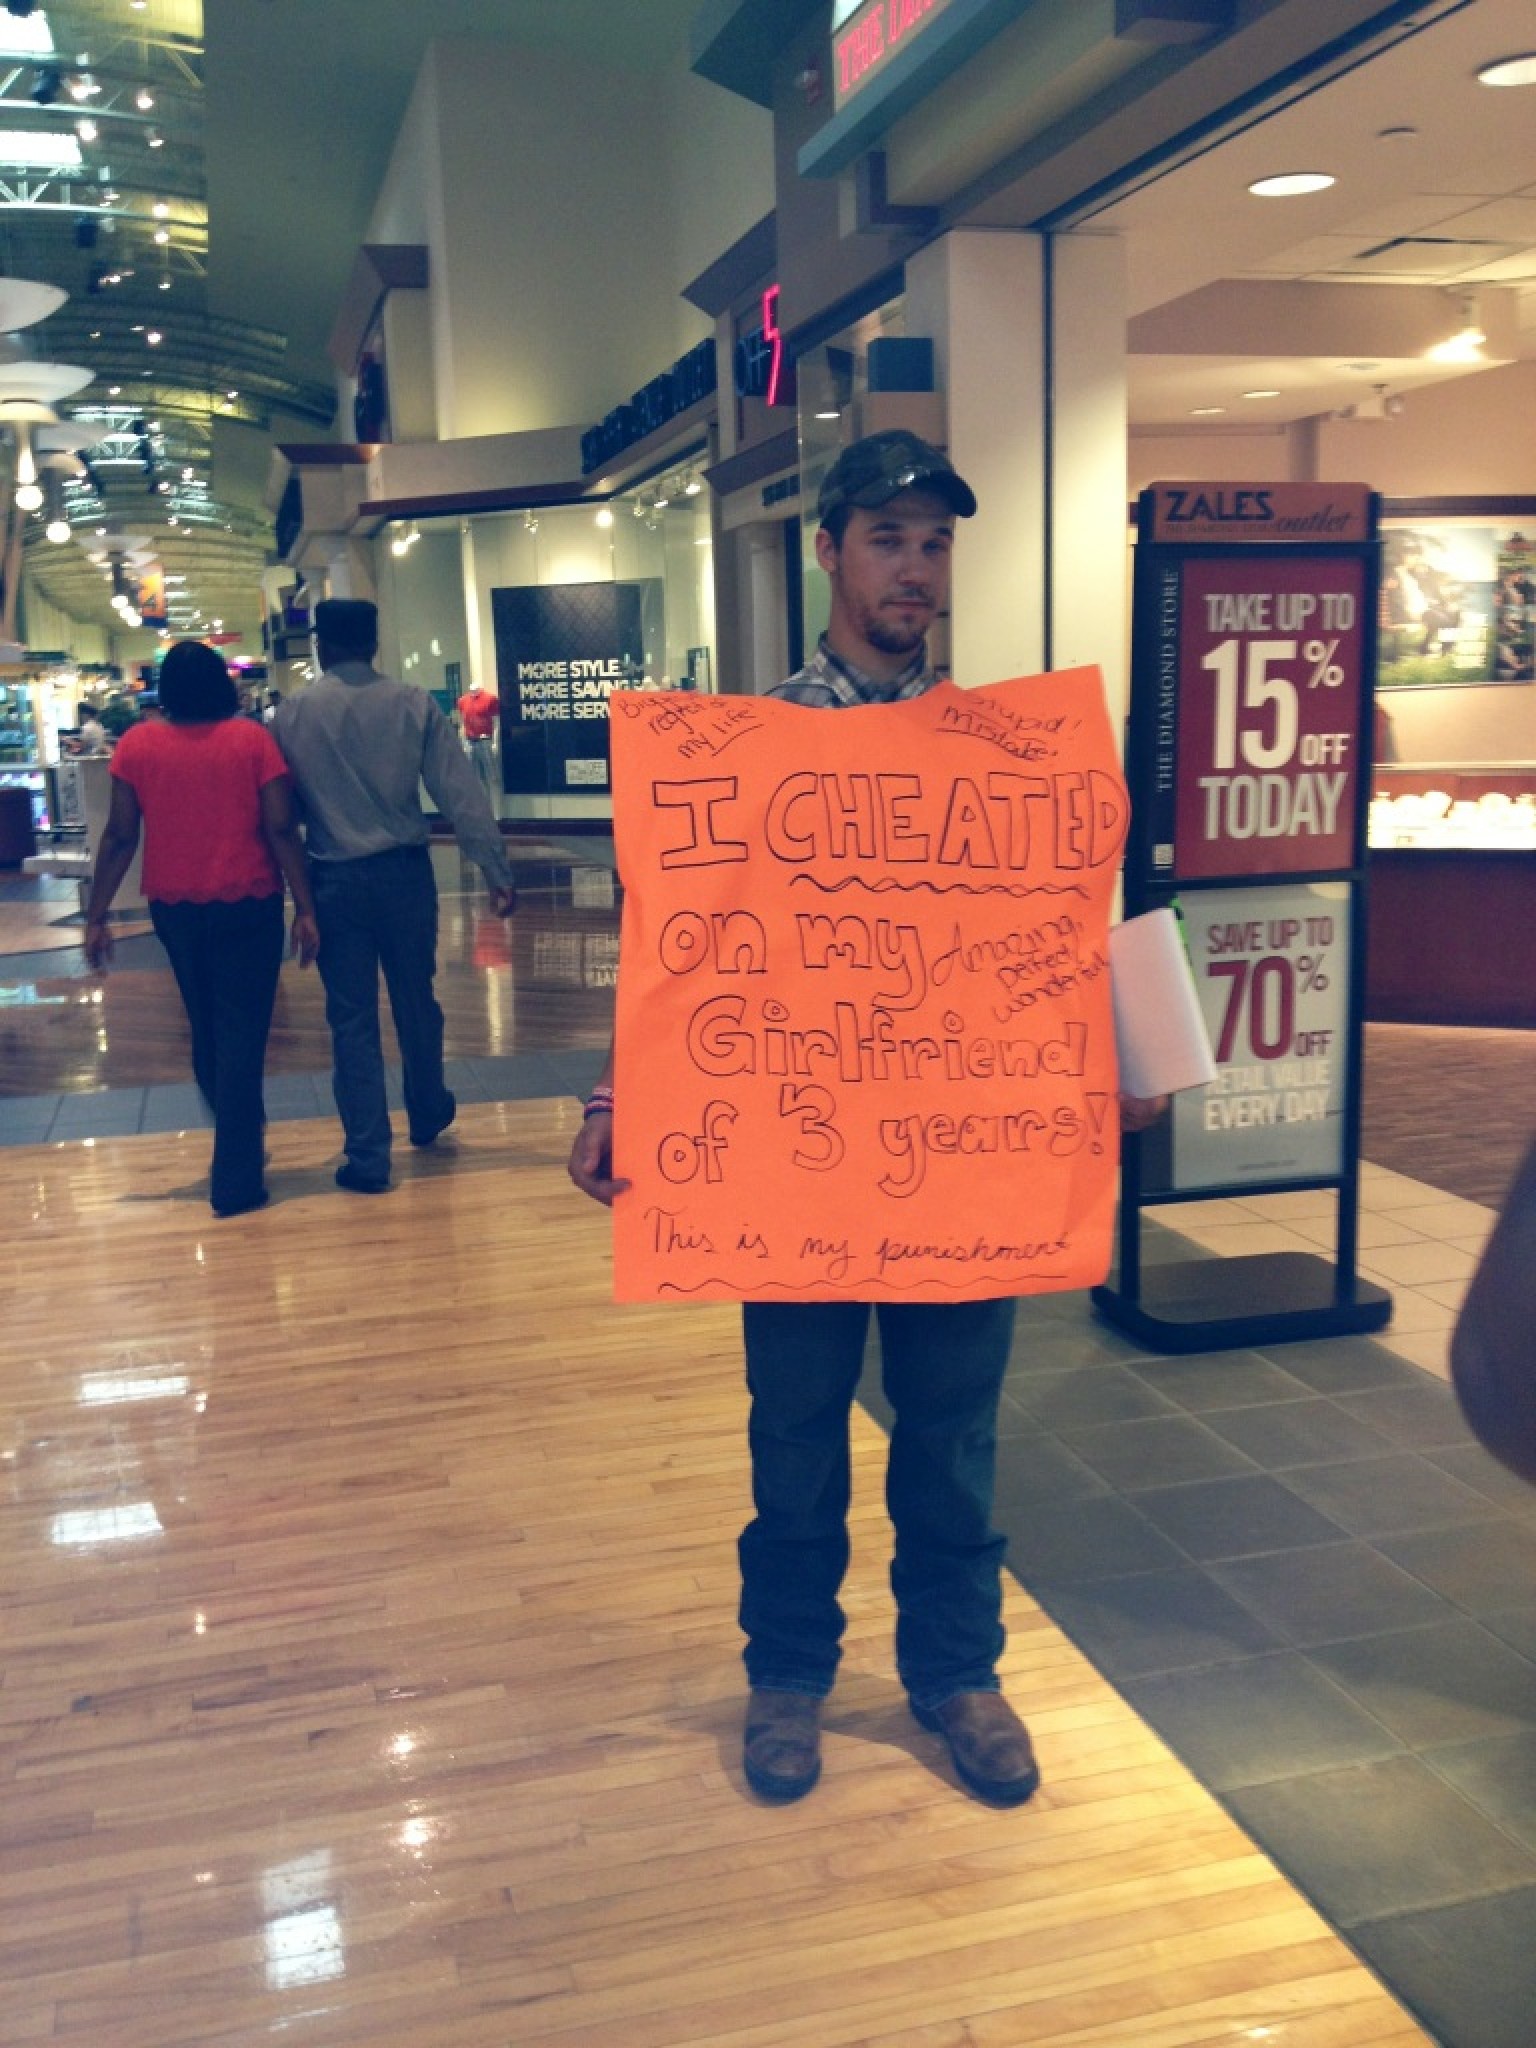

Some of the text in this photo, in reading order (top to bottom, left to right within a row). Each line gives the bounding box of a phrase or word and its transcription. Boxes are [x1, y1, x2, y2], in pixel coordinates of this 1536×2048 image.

[1165, 491, 1275, 522] ZALES
[1204, 593, 1356, 632] TAKE UP TO
[518, 661, 569, 680] MORE
[519, 681, 570, 700] MORE
[1156, 567, 1179, 793] THE DIAMOND STORE
[521, 702, 572, 721] MORE
[1300, 733, 1351, 766] OFF
[651, 770, 1132, 871] I CHEATED
[1197, 771, 1349, 841] TODAY
[1207, 916, 1335, 955] SAVE UP TO
[659, 909, 927, 1012] on my
[686, 993, 1090, 1083] Girlfriend
[1293, 1029, 1334, 1058] OFF
[1203, 1089, 1331, 1132] EVERY DAY
[657, 1083, 1110, 1198] of 3 years!
[643, 1205, 1071, 1281] This is my punishment
